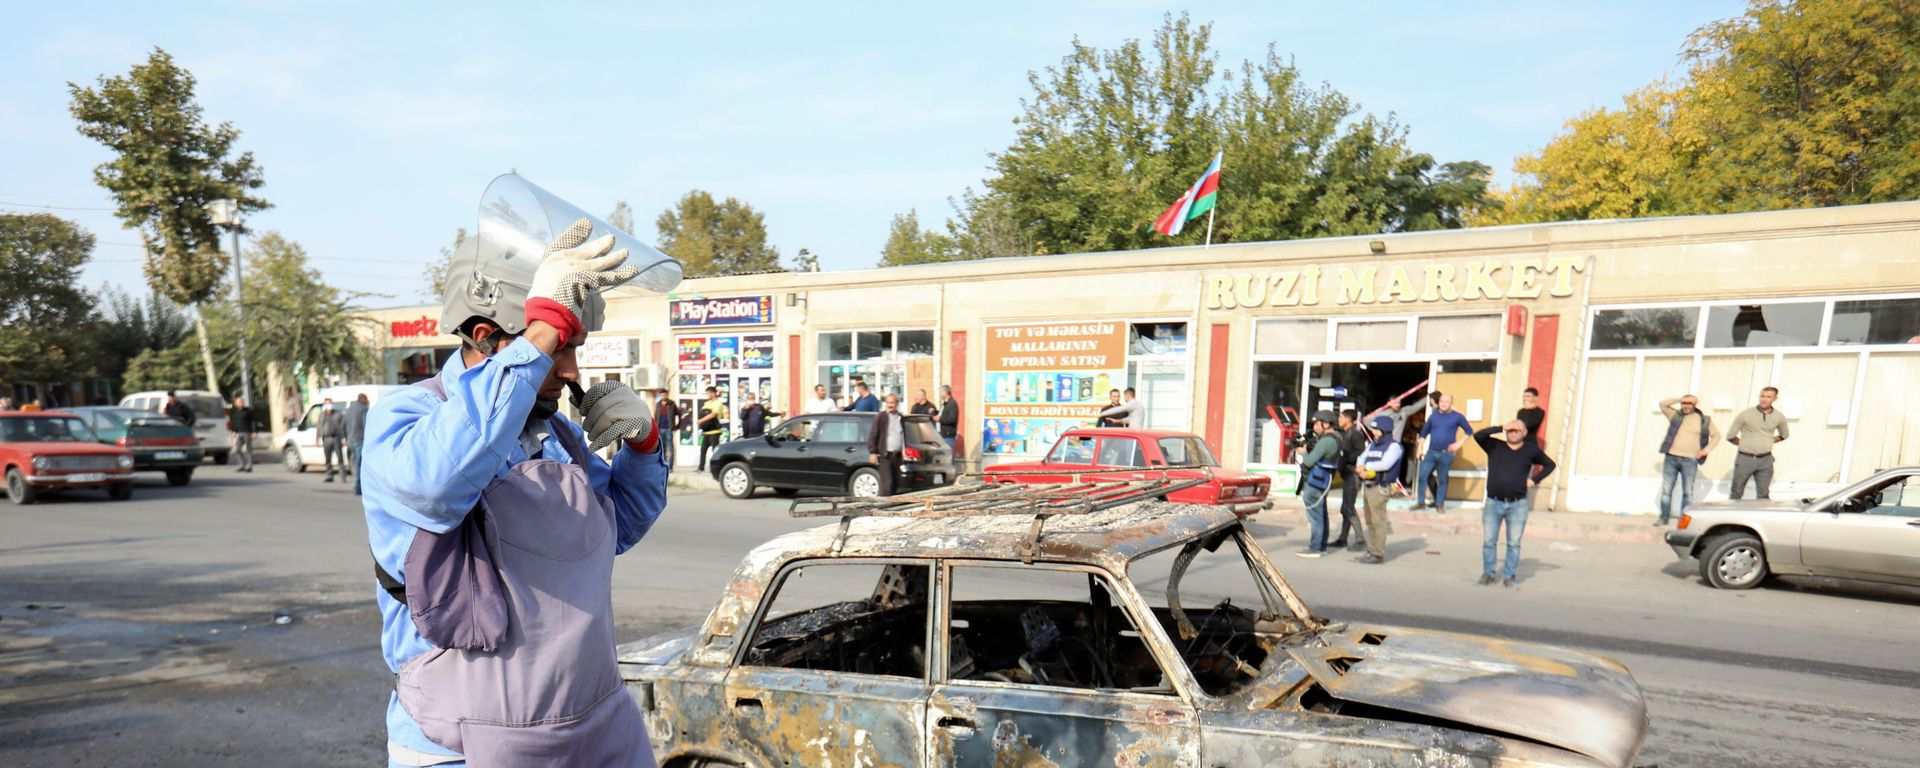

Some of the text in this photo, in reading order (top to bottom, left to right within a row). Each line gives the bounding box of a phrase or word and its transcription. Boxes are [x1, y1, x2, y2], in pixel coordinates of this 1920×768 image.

[1207, 256, 1584, 310] RUZİ MARKET
[680, 299, 758, 324] PlayStation
[995, 322, 1115, 338] TOY VƏ MƏRASİM
[1009, 340, 1099, 352] MALLARININ
[1000, 355, 1107, 368] TOPDAN SATIŞI
[989, 405, 1102, 417] BONUS HƏDİYYƏLƏ
